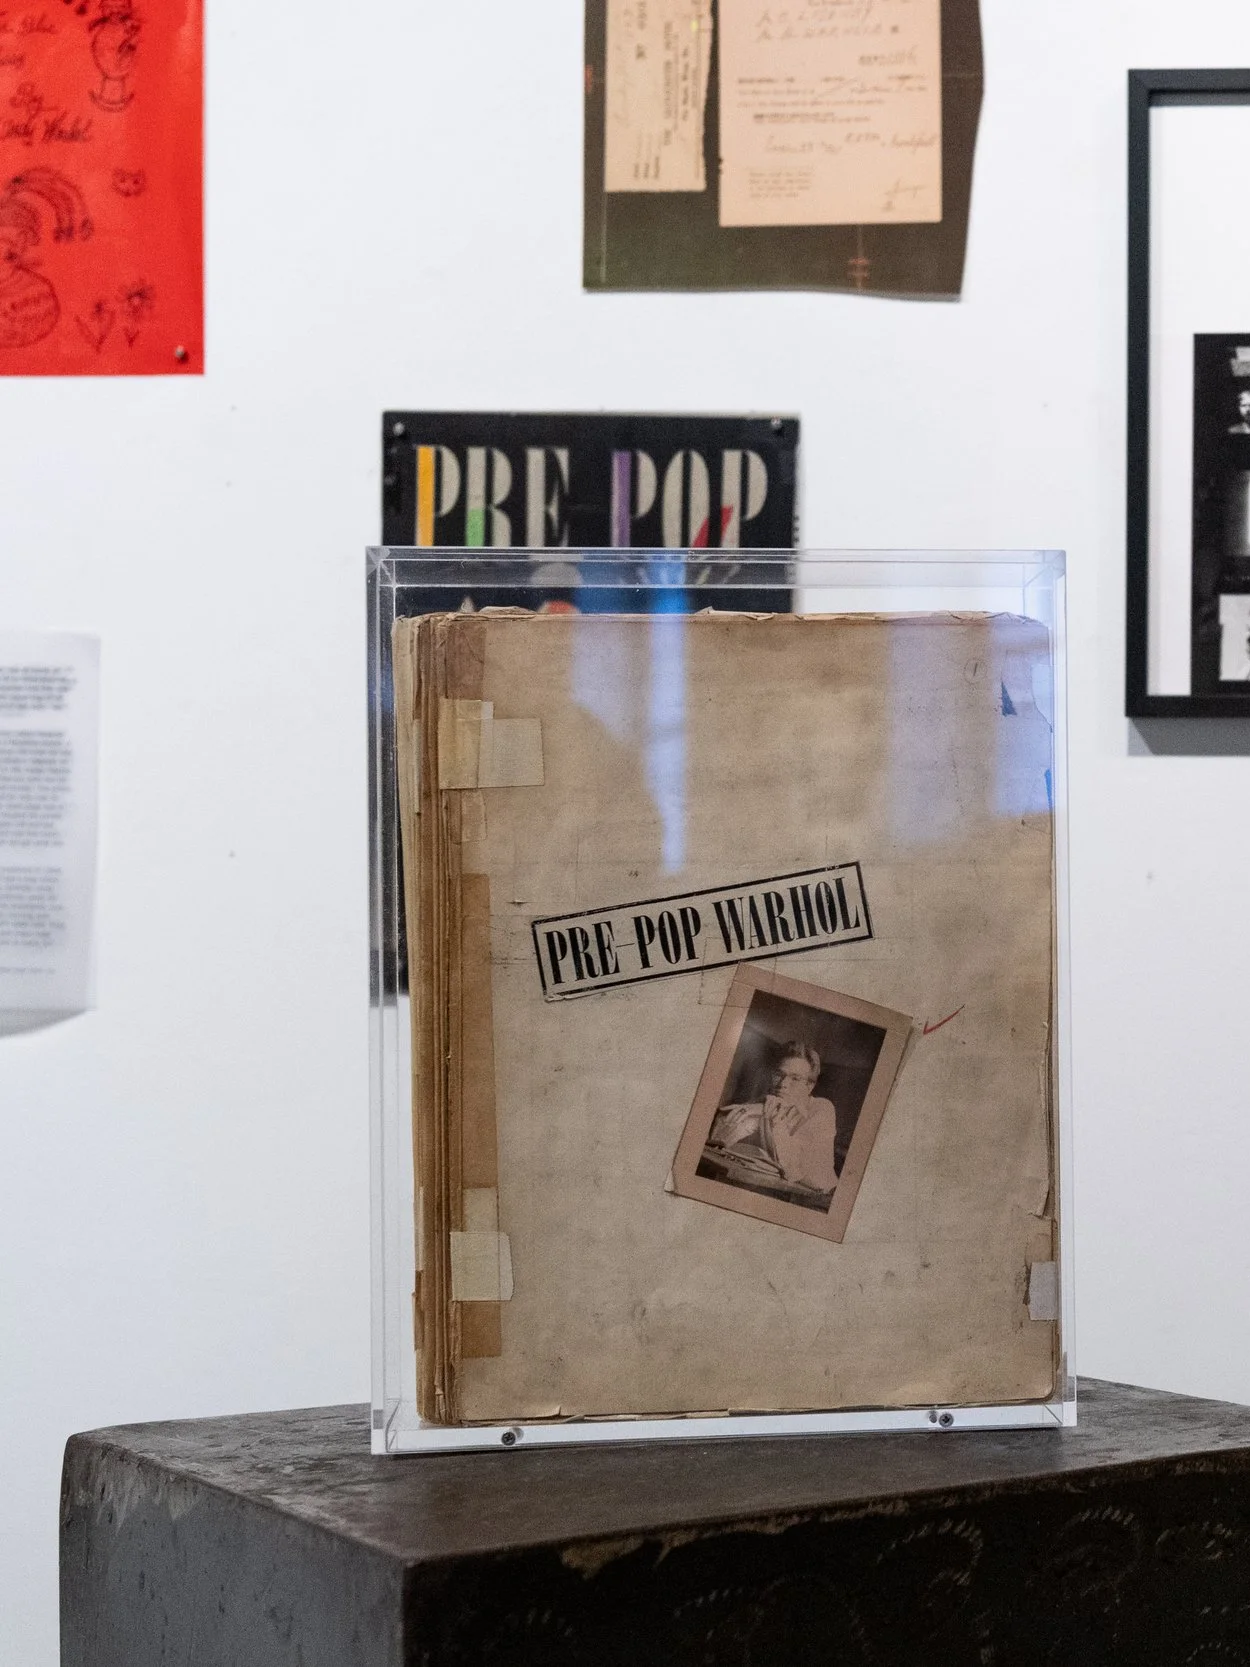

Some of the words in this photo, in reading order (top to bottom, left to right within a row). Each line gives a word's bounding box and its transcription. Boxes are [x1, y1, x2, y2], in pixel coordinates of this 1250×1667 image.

[415, 445, 570, 548] PRE
[610, 448, 768, 549] POP
[712, 876, 861, 955] WARHOL
